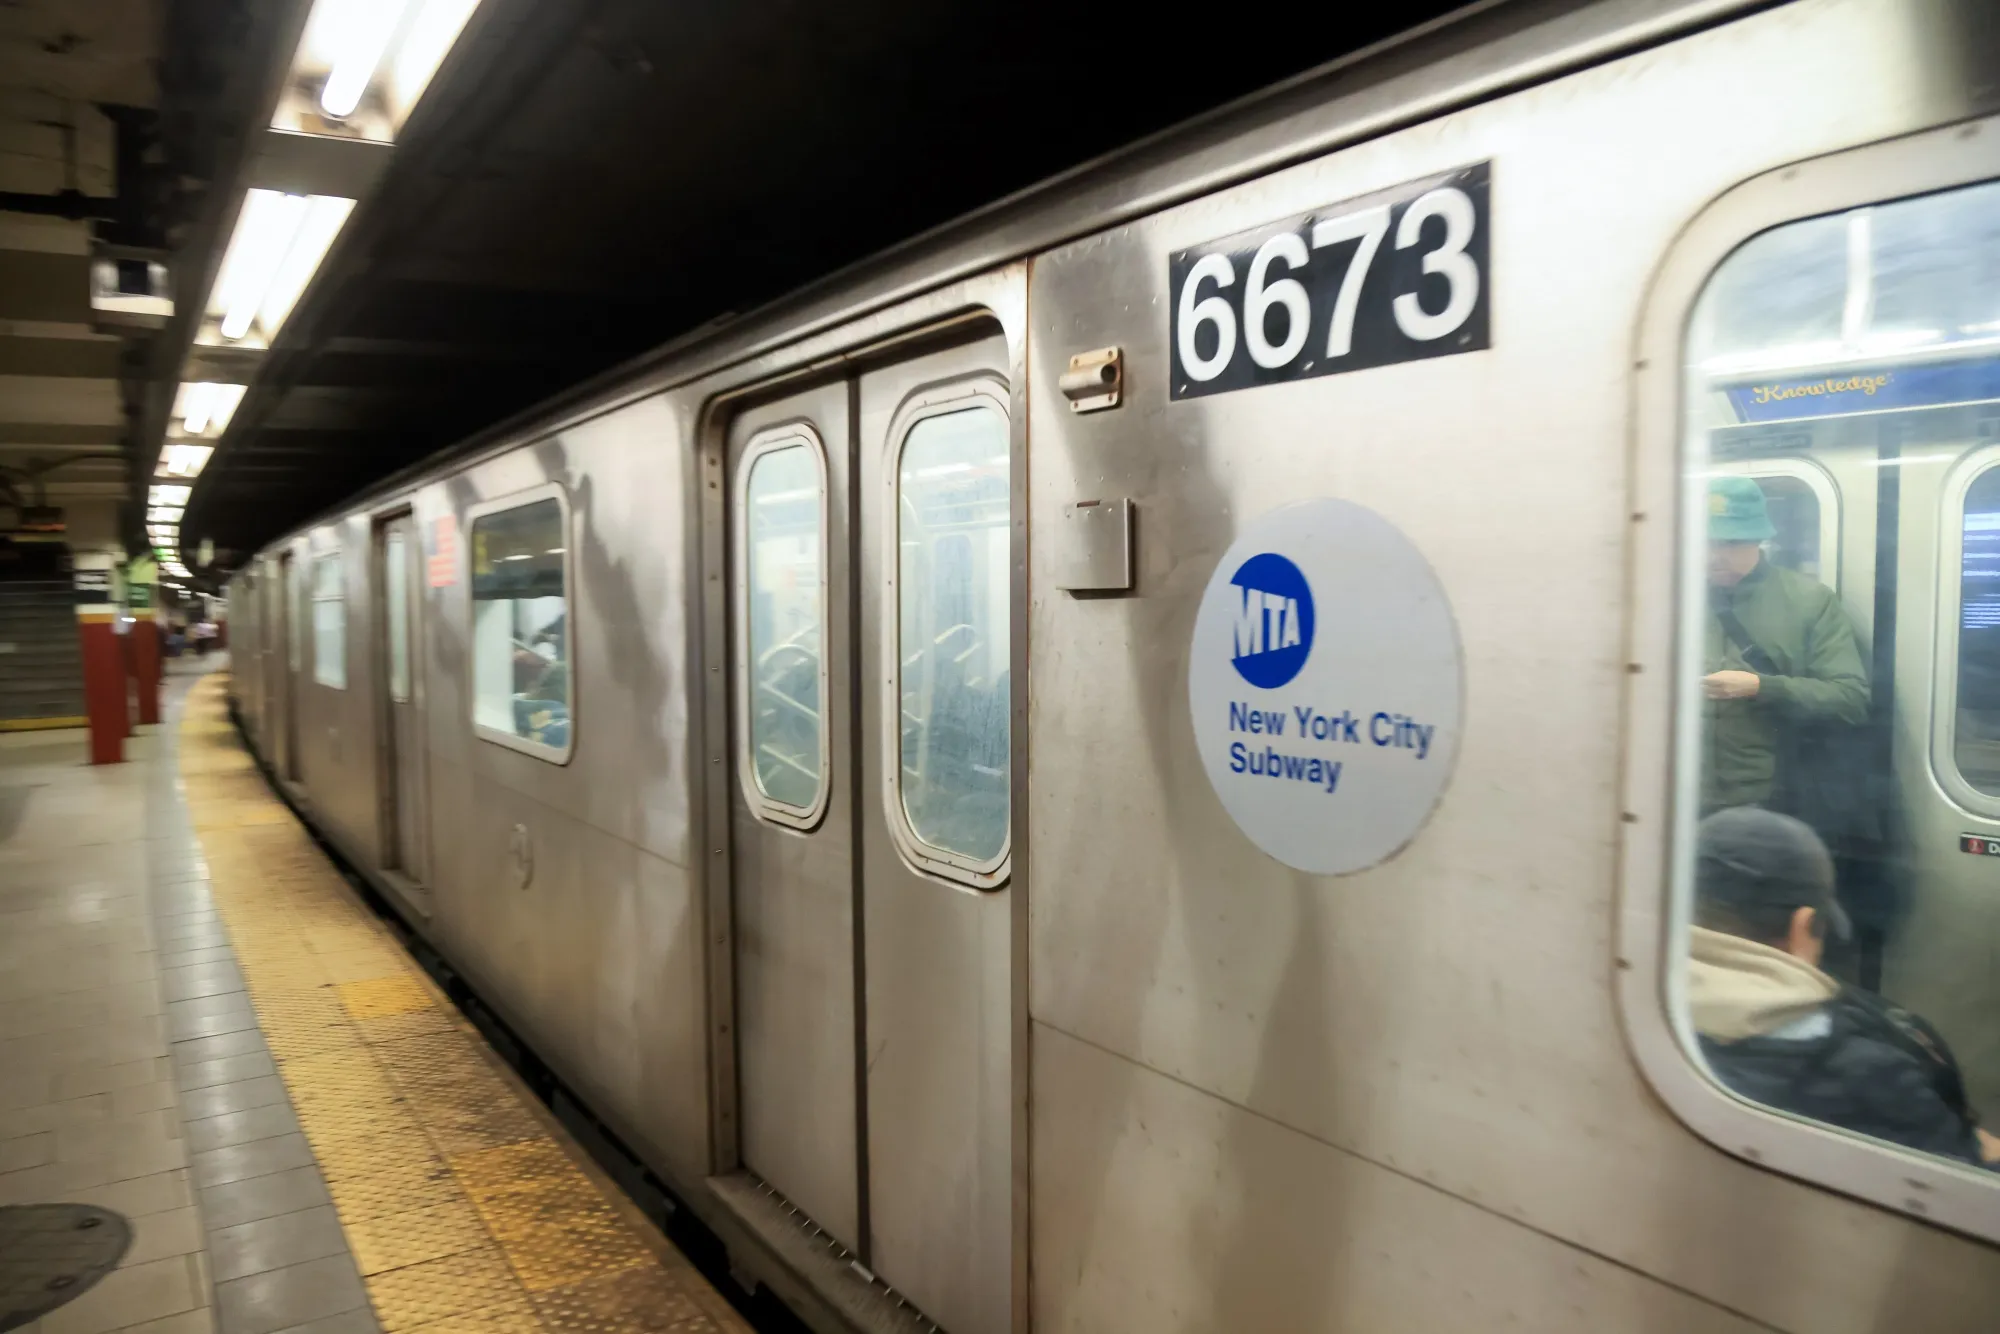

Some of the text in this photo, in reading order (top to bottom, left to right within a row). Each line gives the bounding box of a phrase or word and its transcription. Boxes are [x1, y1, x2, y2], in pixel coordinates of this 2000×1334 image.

[1178, 187, 1480, 382] 6673
[1753, 375, 1887, 403] Knowledge
[1231, 584, 1301, 658] MTA
[1230, 701, 1437, 760] New York City
[1230, 742, 1343, 793] Subway
